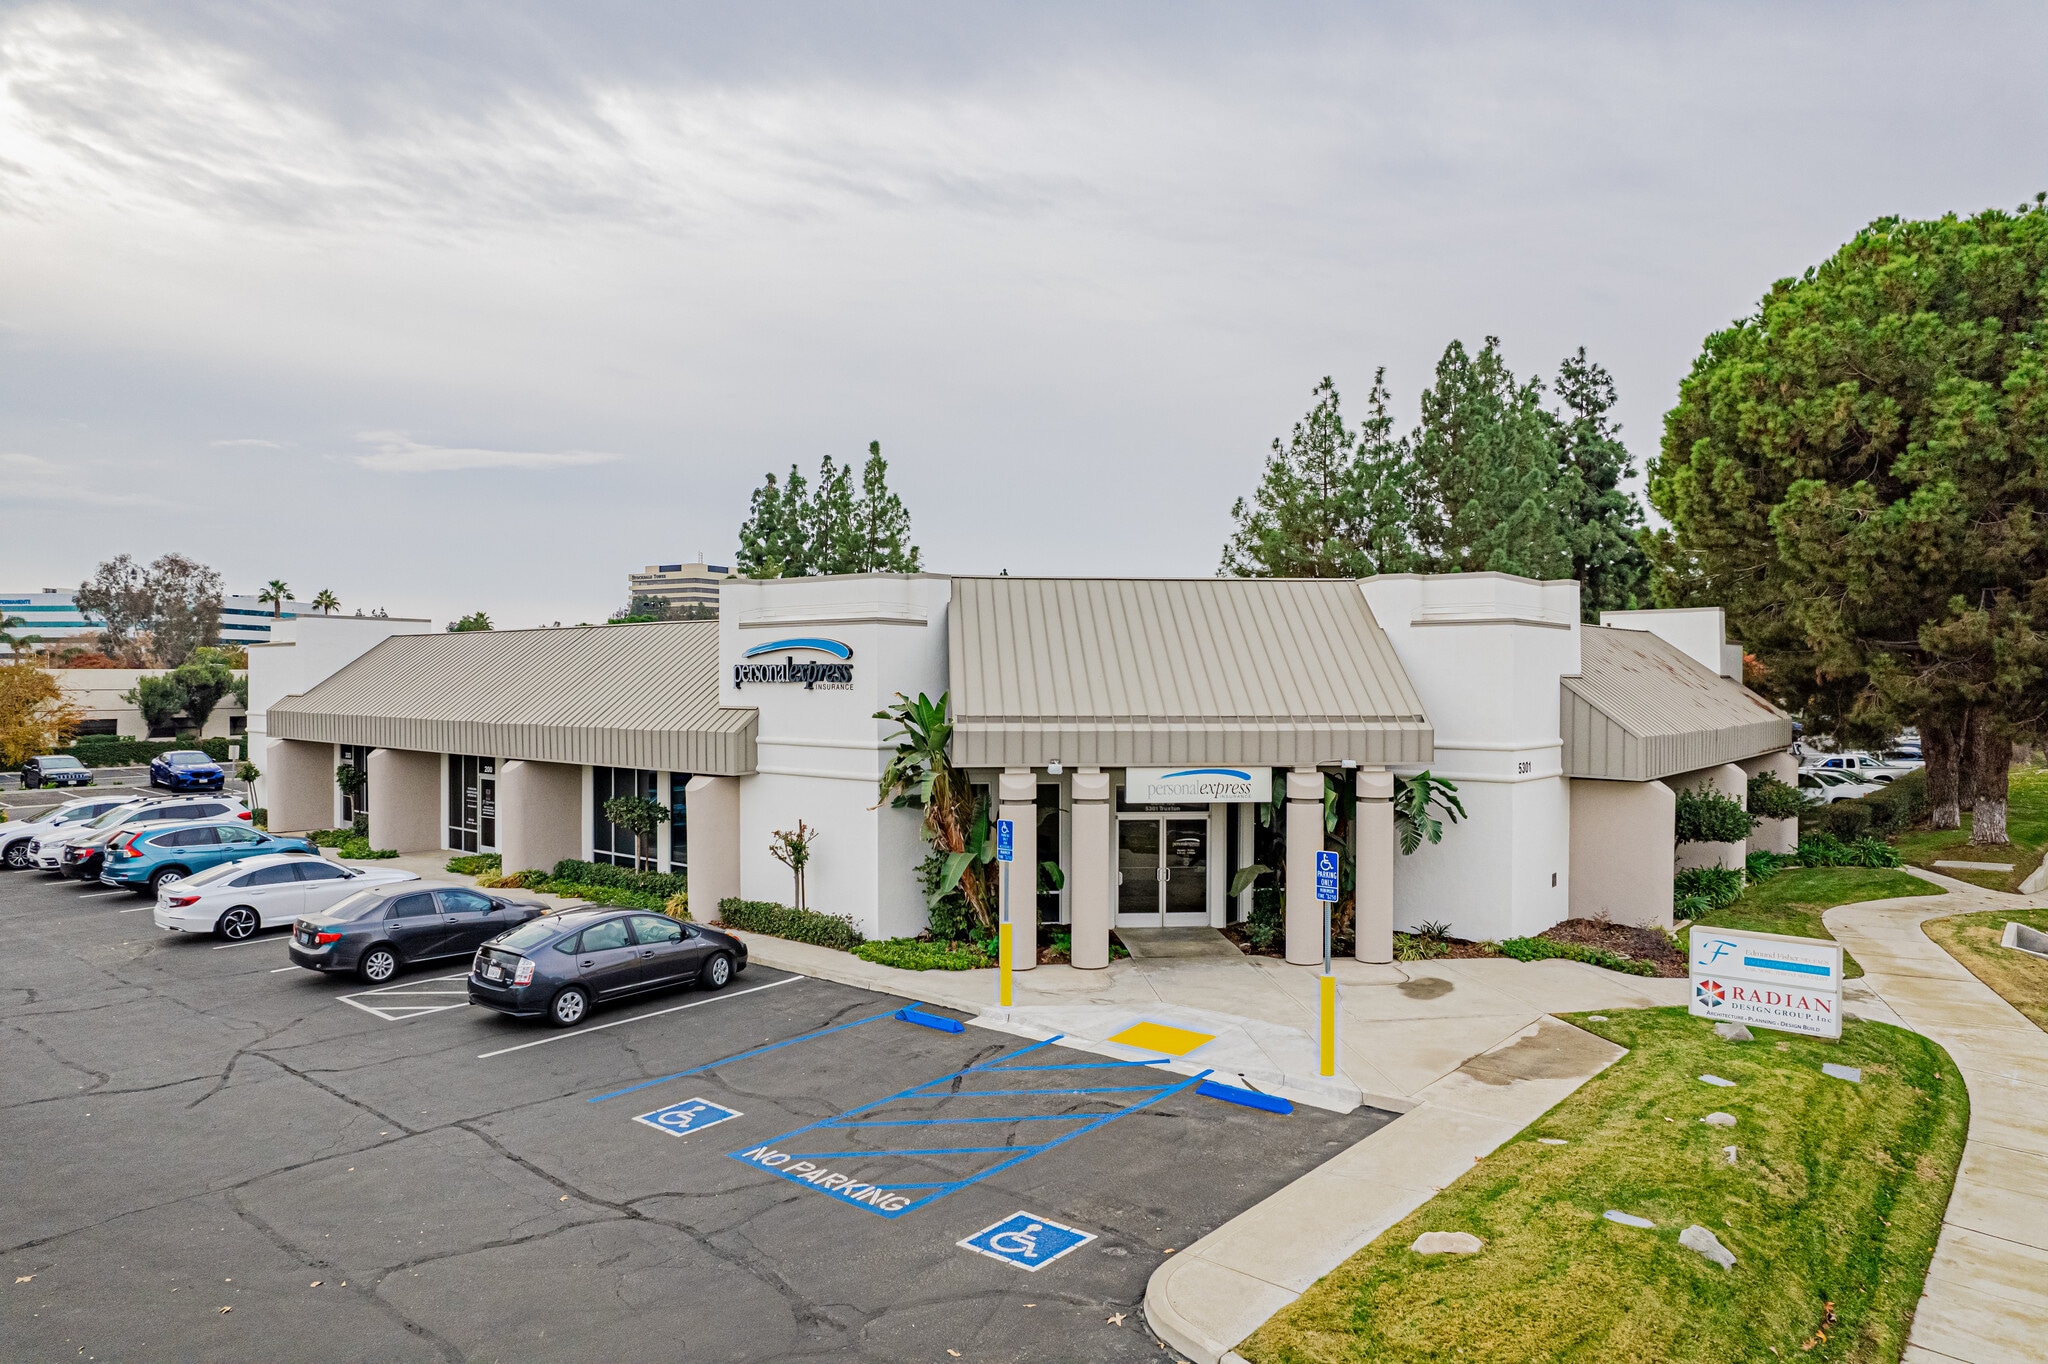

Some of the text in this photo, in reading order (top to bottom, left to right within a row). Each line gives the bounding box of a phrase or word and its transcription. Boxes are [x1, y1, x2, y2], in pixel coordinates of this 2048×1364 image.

[1519, 761, 1531, 774] 5301
[1317, 870, 1337, 879] PARKING
[1745, 949, 1776, 959] Edmund
[1777, 953, 1799, 962] Fisher
[1732, 986, 1832, 1013] RADIAN
[1731, 1002, 1832, 1023] DESIGN GROUP, Inc
[742, 1146, 911, 1211] NO PARKING
